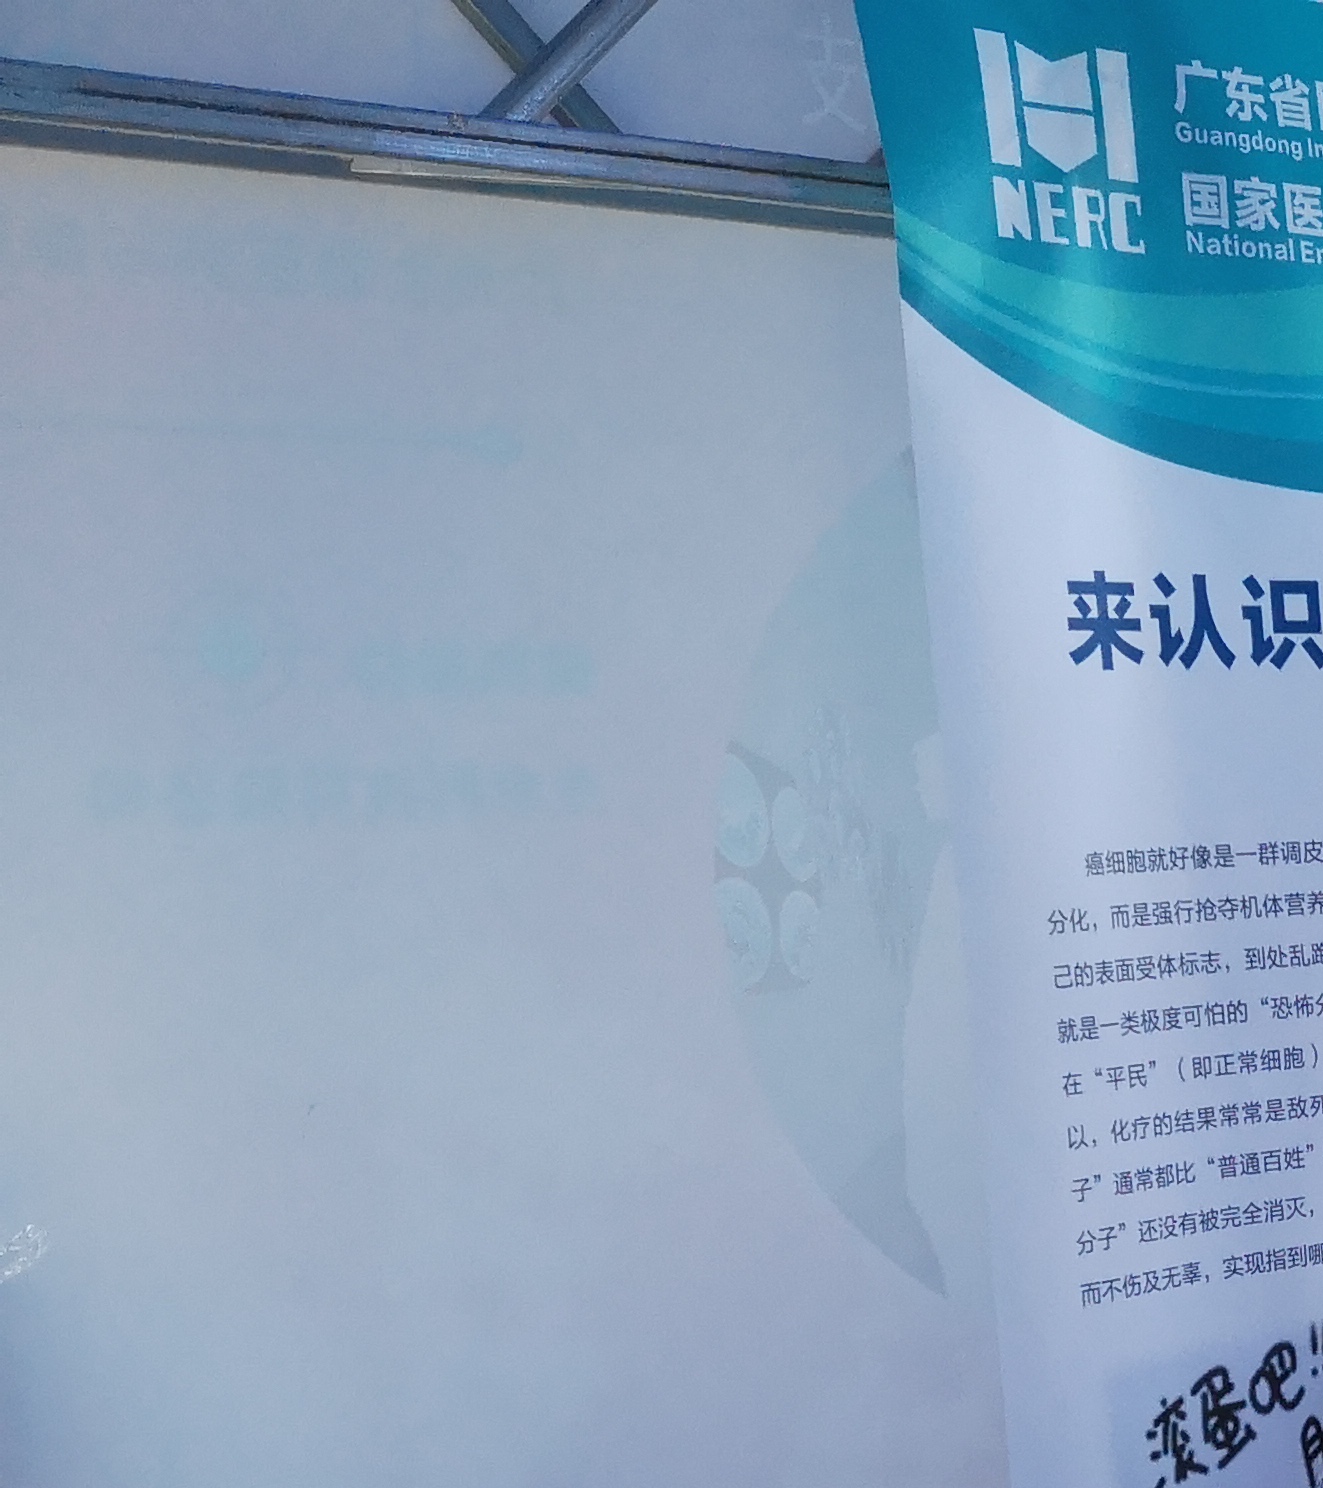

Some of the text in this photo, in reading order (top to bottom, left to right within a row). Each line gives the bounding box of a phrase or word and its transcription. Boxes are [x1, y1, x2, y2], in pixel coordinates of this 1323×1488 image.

[1175, 121, 1302, 161] Guangdong
[992, 175, 1145, 255] NERC
[1186, 229, 1295, 264] National
